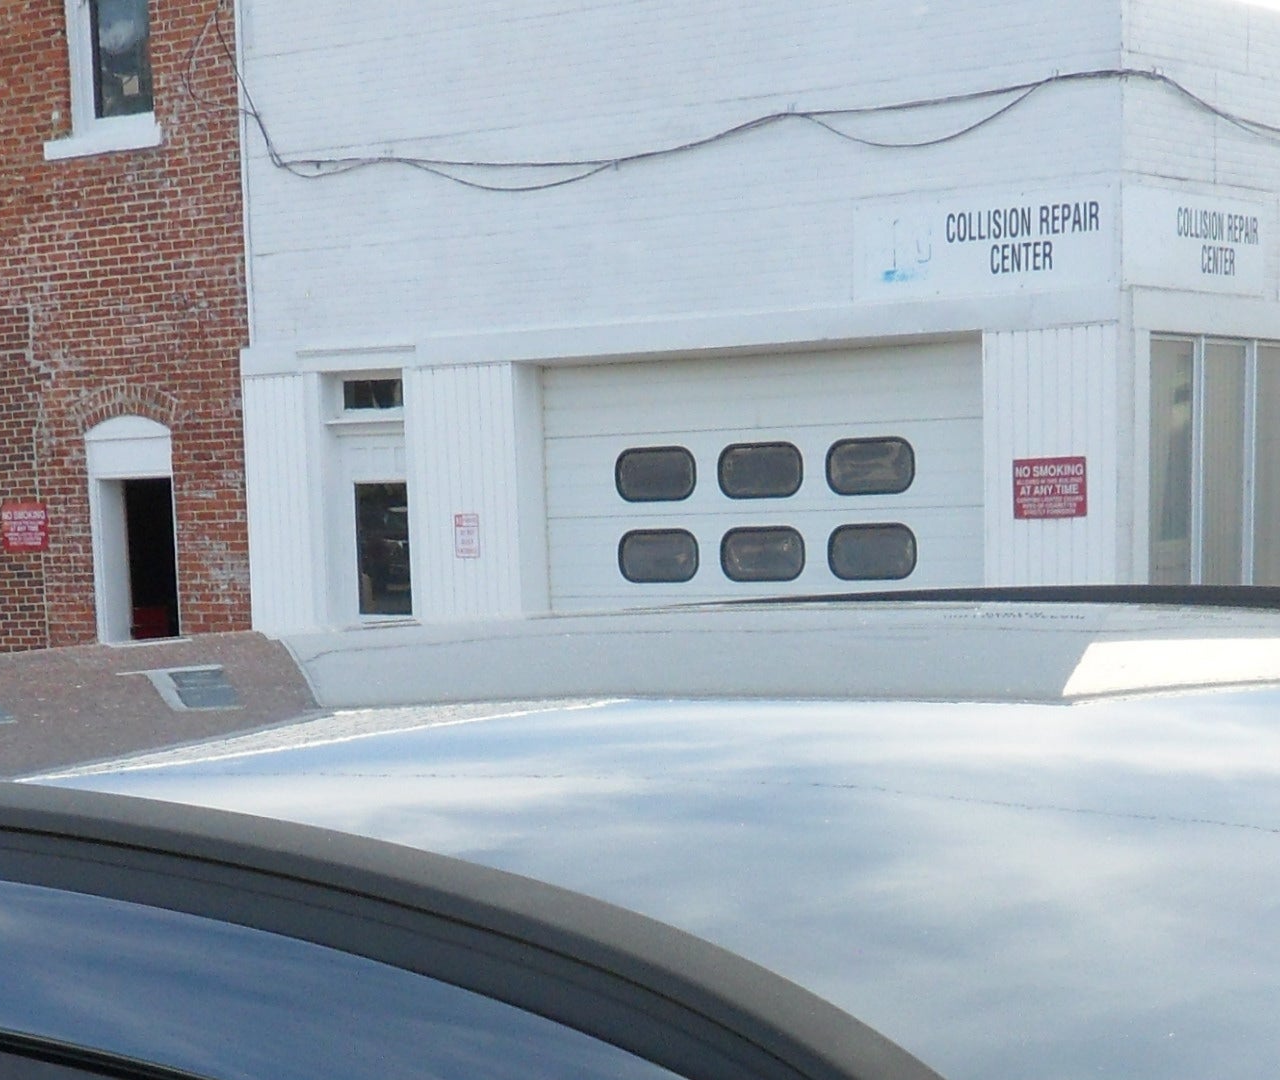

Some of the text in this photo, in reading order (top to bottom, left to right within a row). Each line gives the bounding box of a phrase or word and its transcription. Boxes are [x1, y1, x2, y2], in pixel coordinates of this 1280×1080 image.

[946, 201, 1099, 243] COLLISION REPAIR
[1177, 206, 1258, 245] COLLISION REPAIR
[990, 241, 1053, 274] CENTER
[1201, 244, 1235, 276] CENTER
[1015, 464, 1084, 477] NO SMOKING
[1020, 483, 1079, 496] AT ANY TIME
